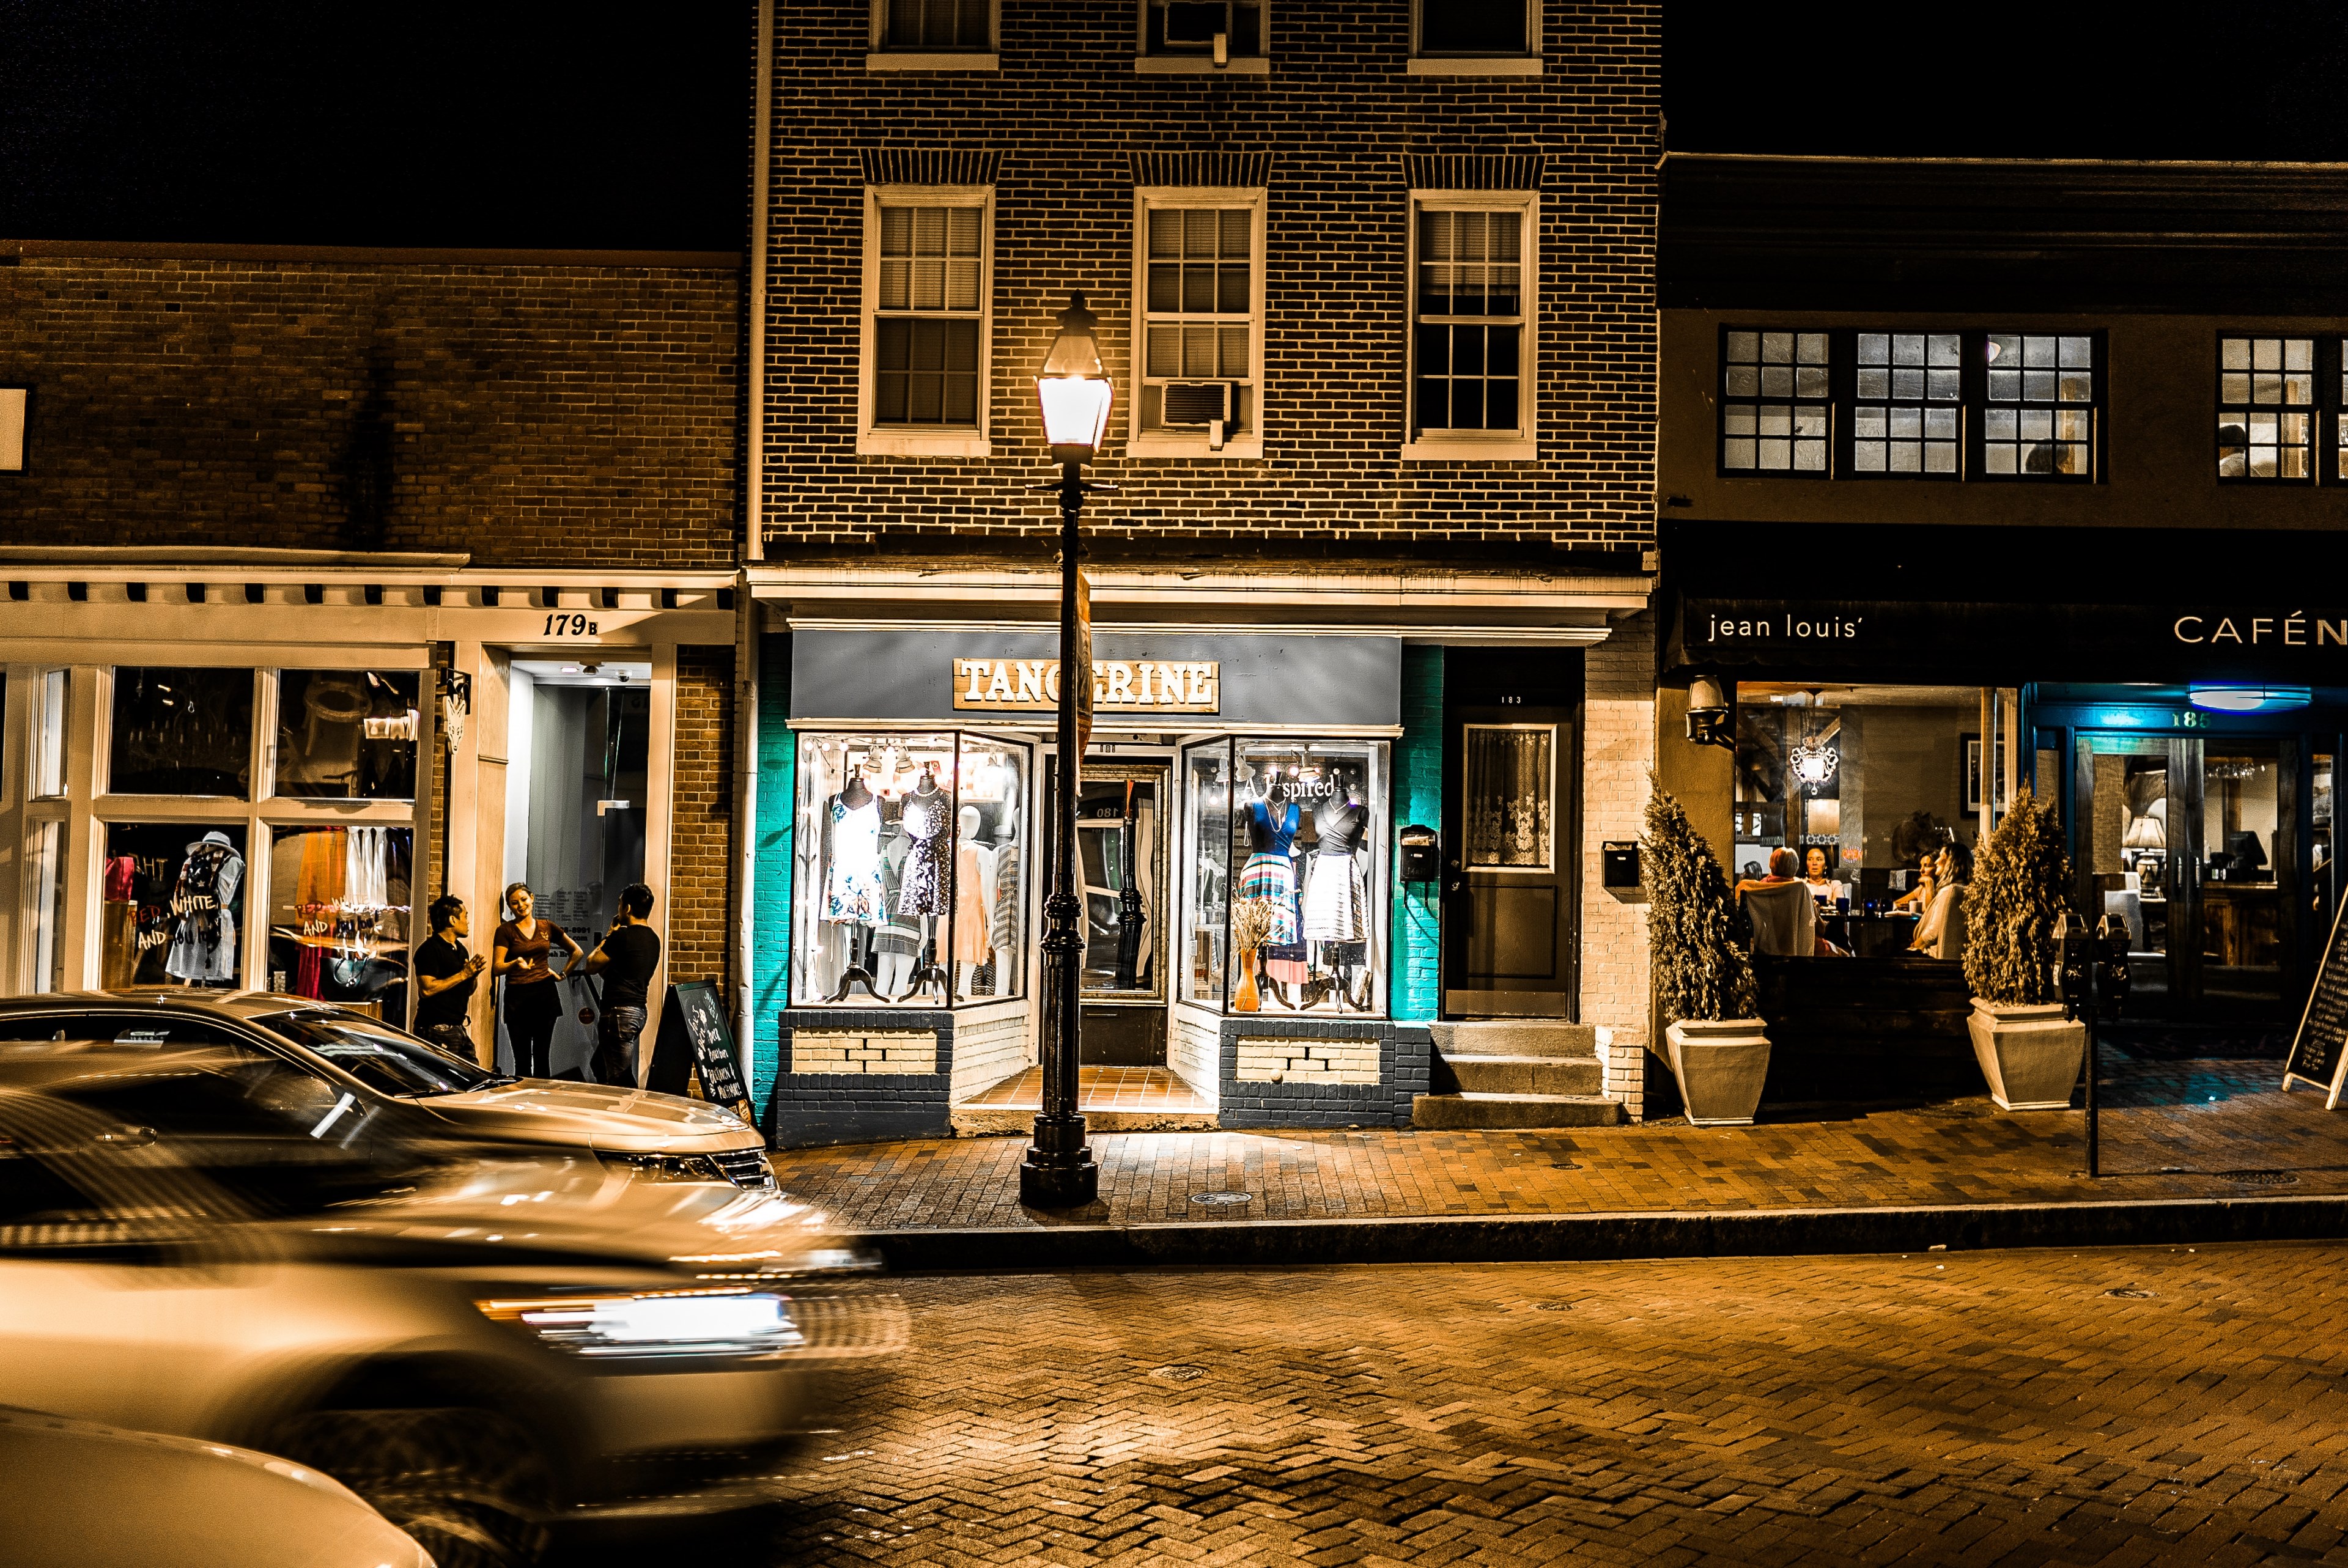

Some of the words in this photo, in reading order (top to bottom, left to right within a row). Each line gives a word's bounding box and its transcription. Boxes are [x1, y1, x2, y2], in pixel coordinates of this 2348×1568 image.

[1708, 614, 1770, 642] jean
[2172, 711, 2212, 729] 185
[303, 919, 328, 937] AND
[138, 930, 167, 951] AND
